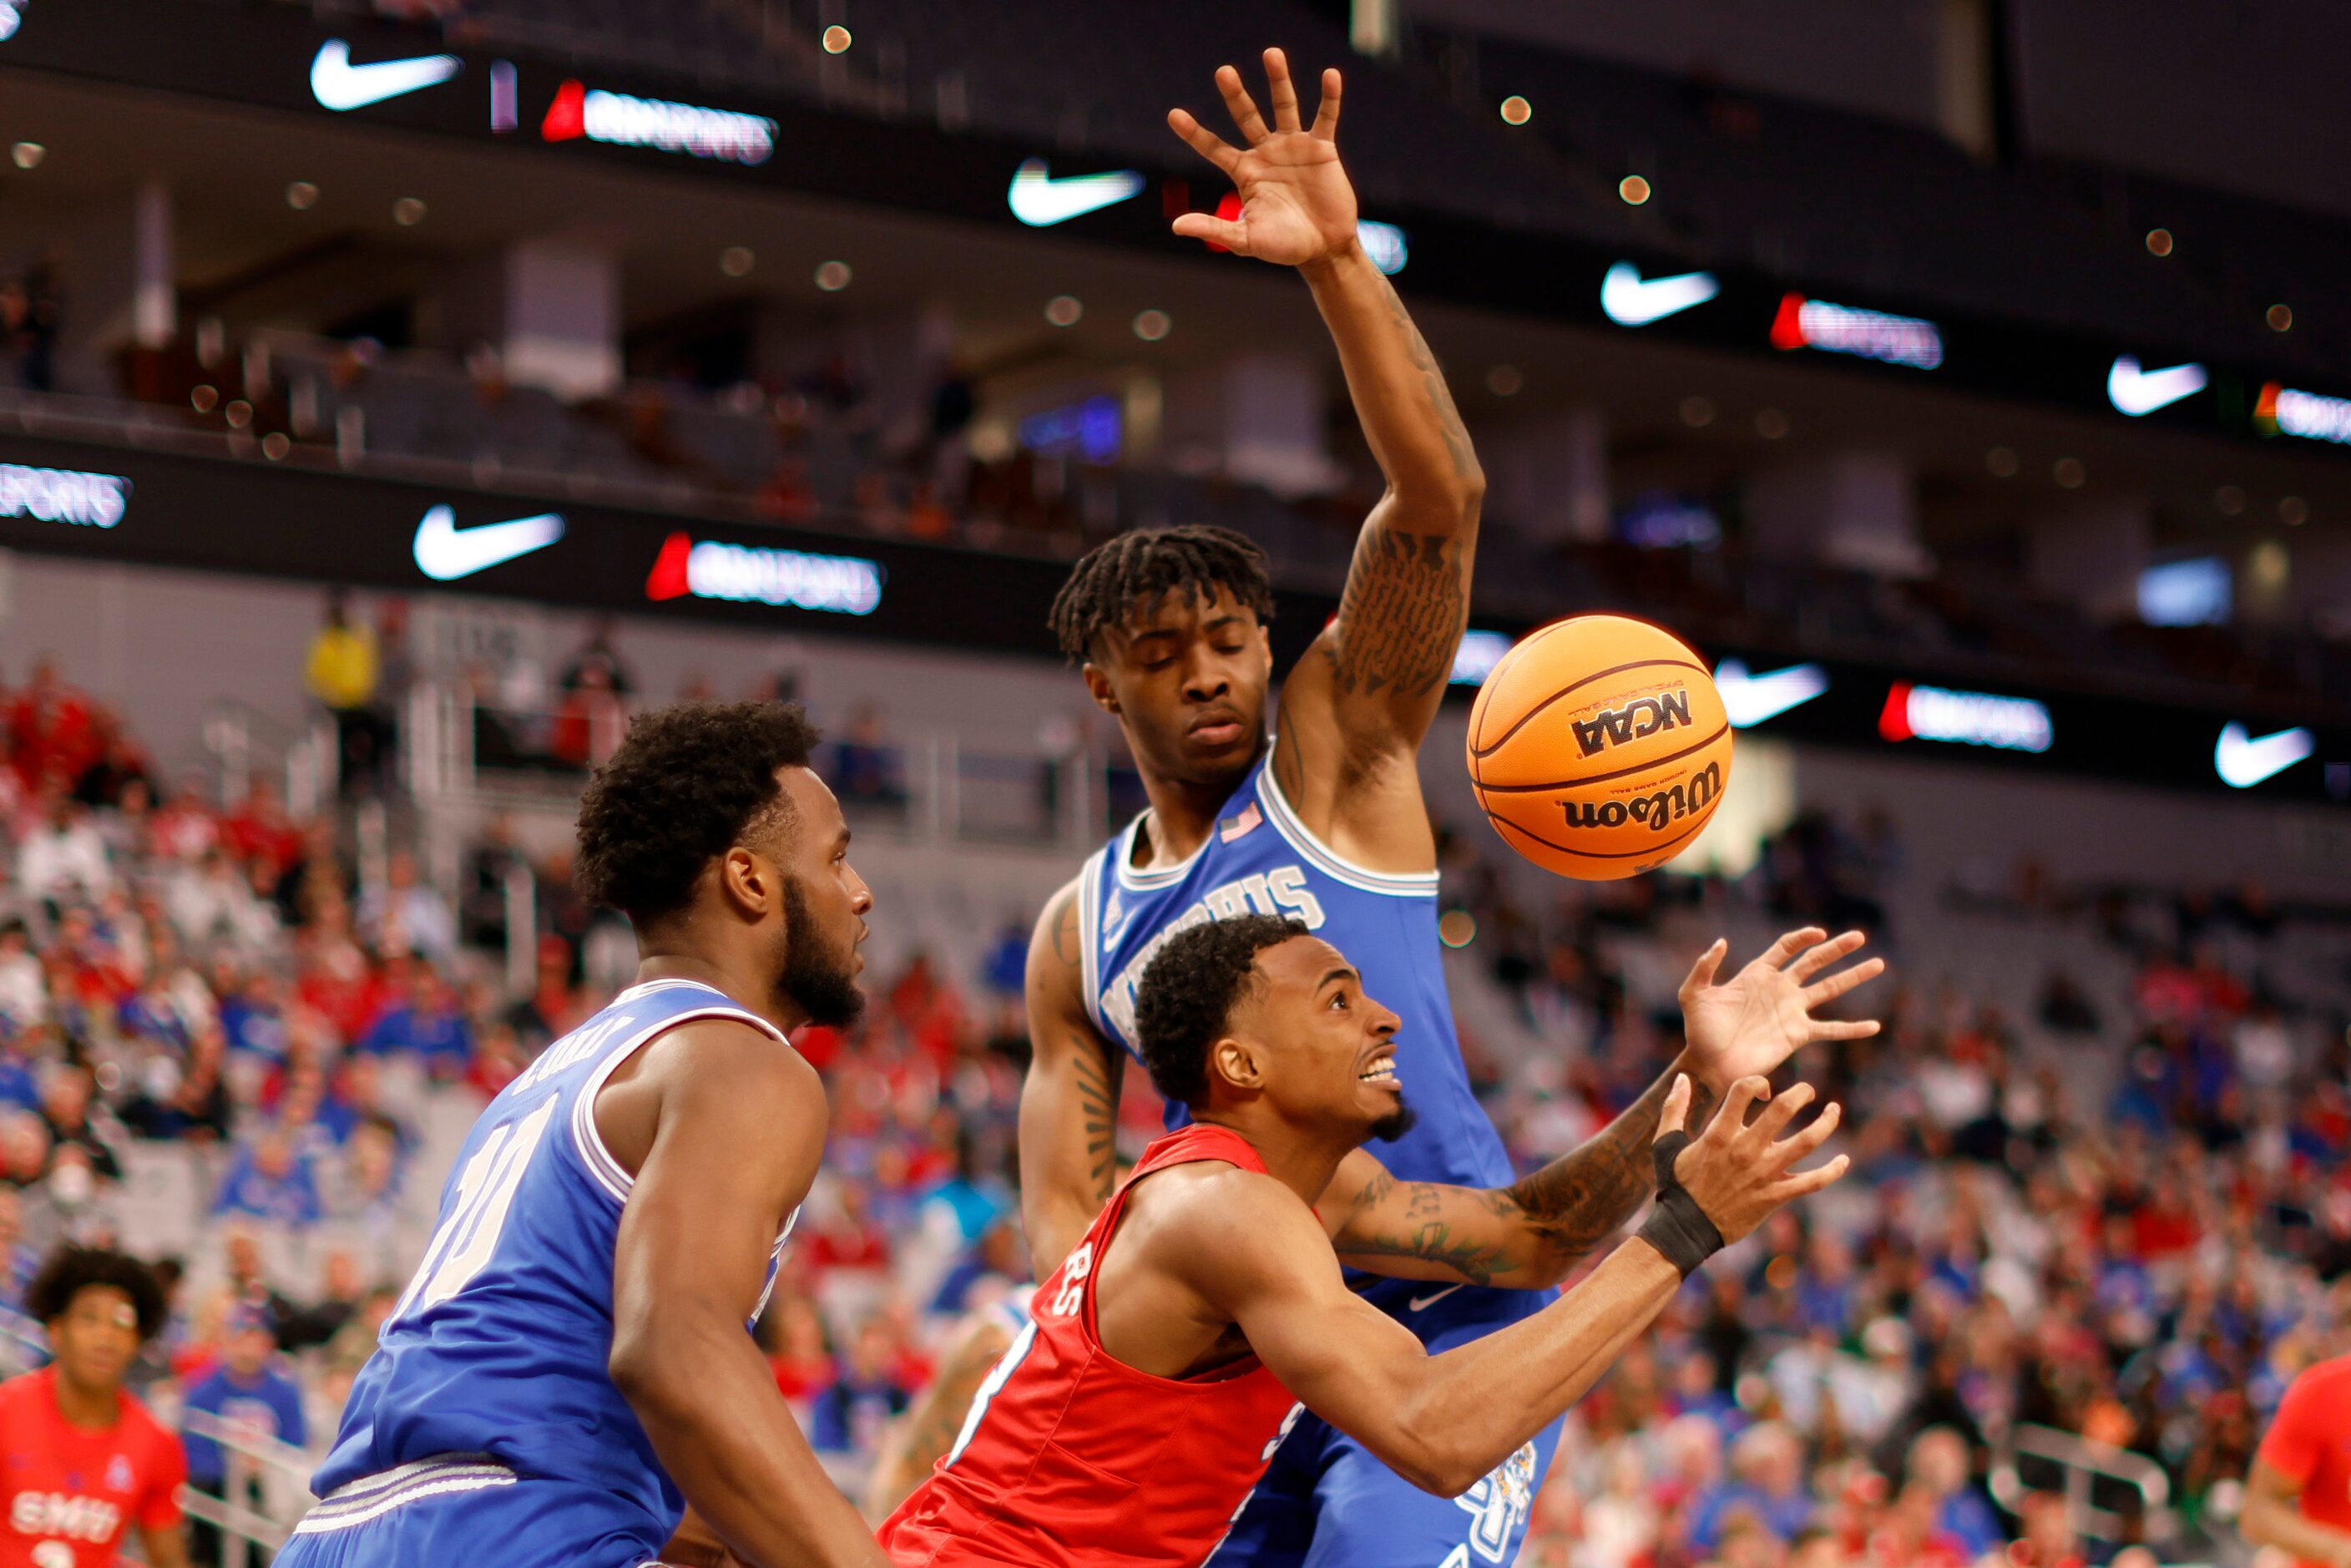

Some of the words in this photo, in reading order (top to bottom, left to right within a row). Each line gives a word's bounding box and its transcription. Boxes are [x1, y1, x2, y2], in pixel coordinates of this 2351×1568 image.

[1568, 701, 1600, 716] BALL
[1570, 690, 1691, 757] NCAA
[1562, 761, 1722, 831] Wilson
[1610, 787, 1631, 797] BALL
[1660, 769, 1687, 784] INDOOR
[1100, 865, 1326, 1059] MHIS
[384, 1092, 559, 1337] 10
[1052, 1241, 1093, 1317] RS
